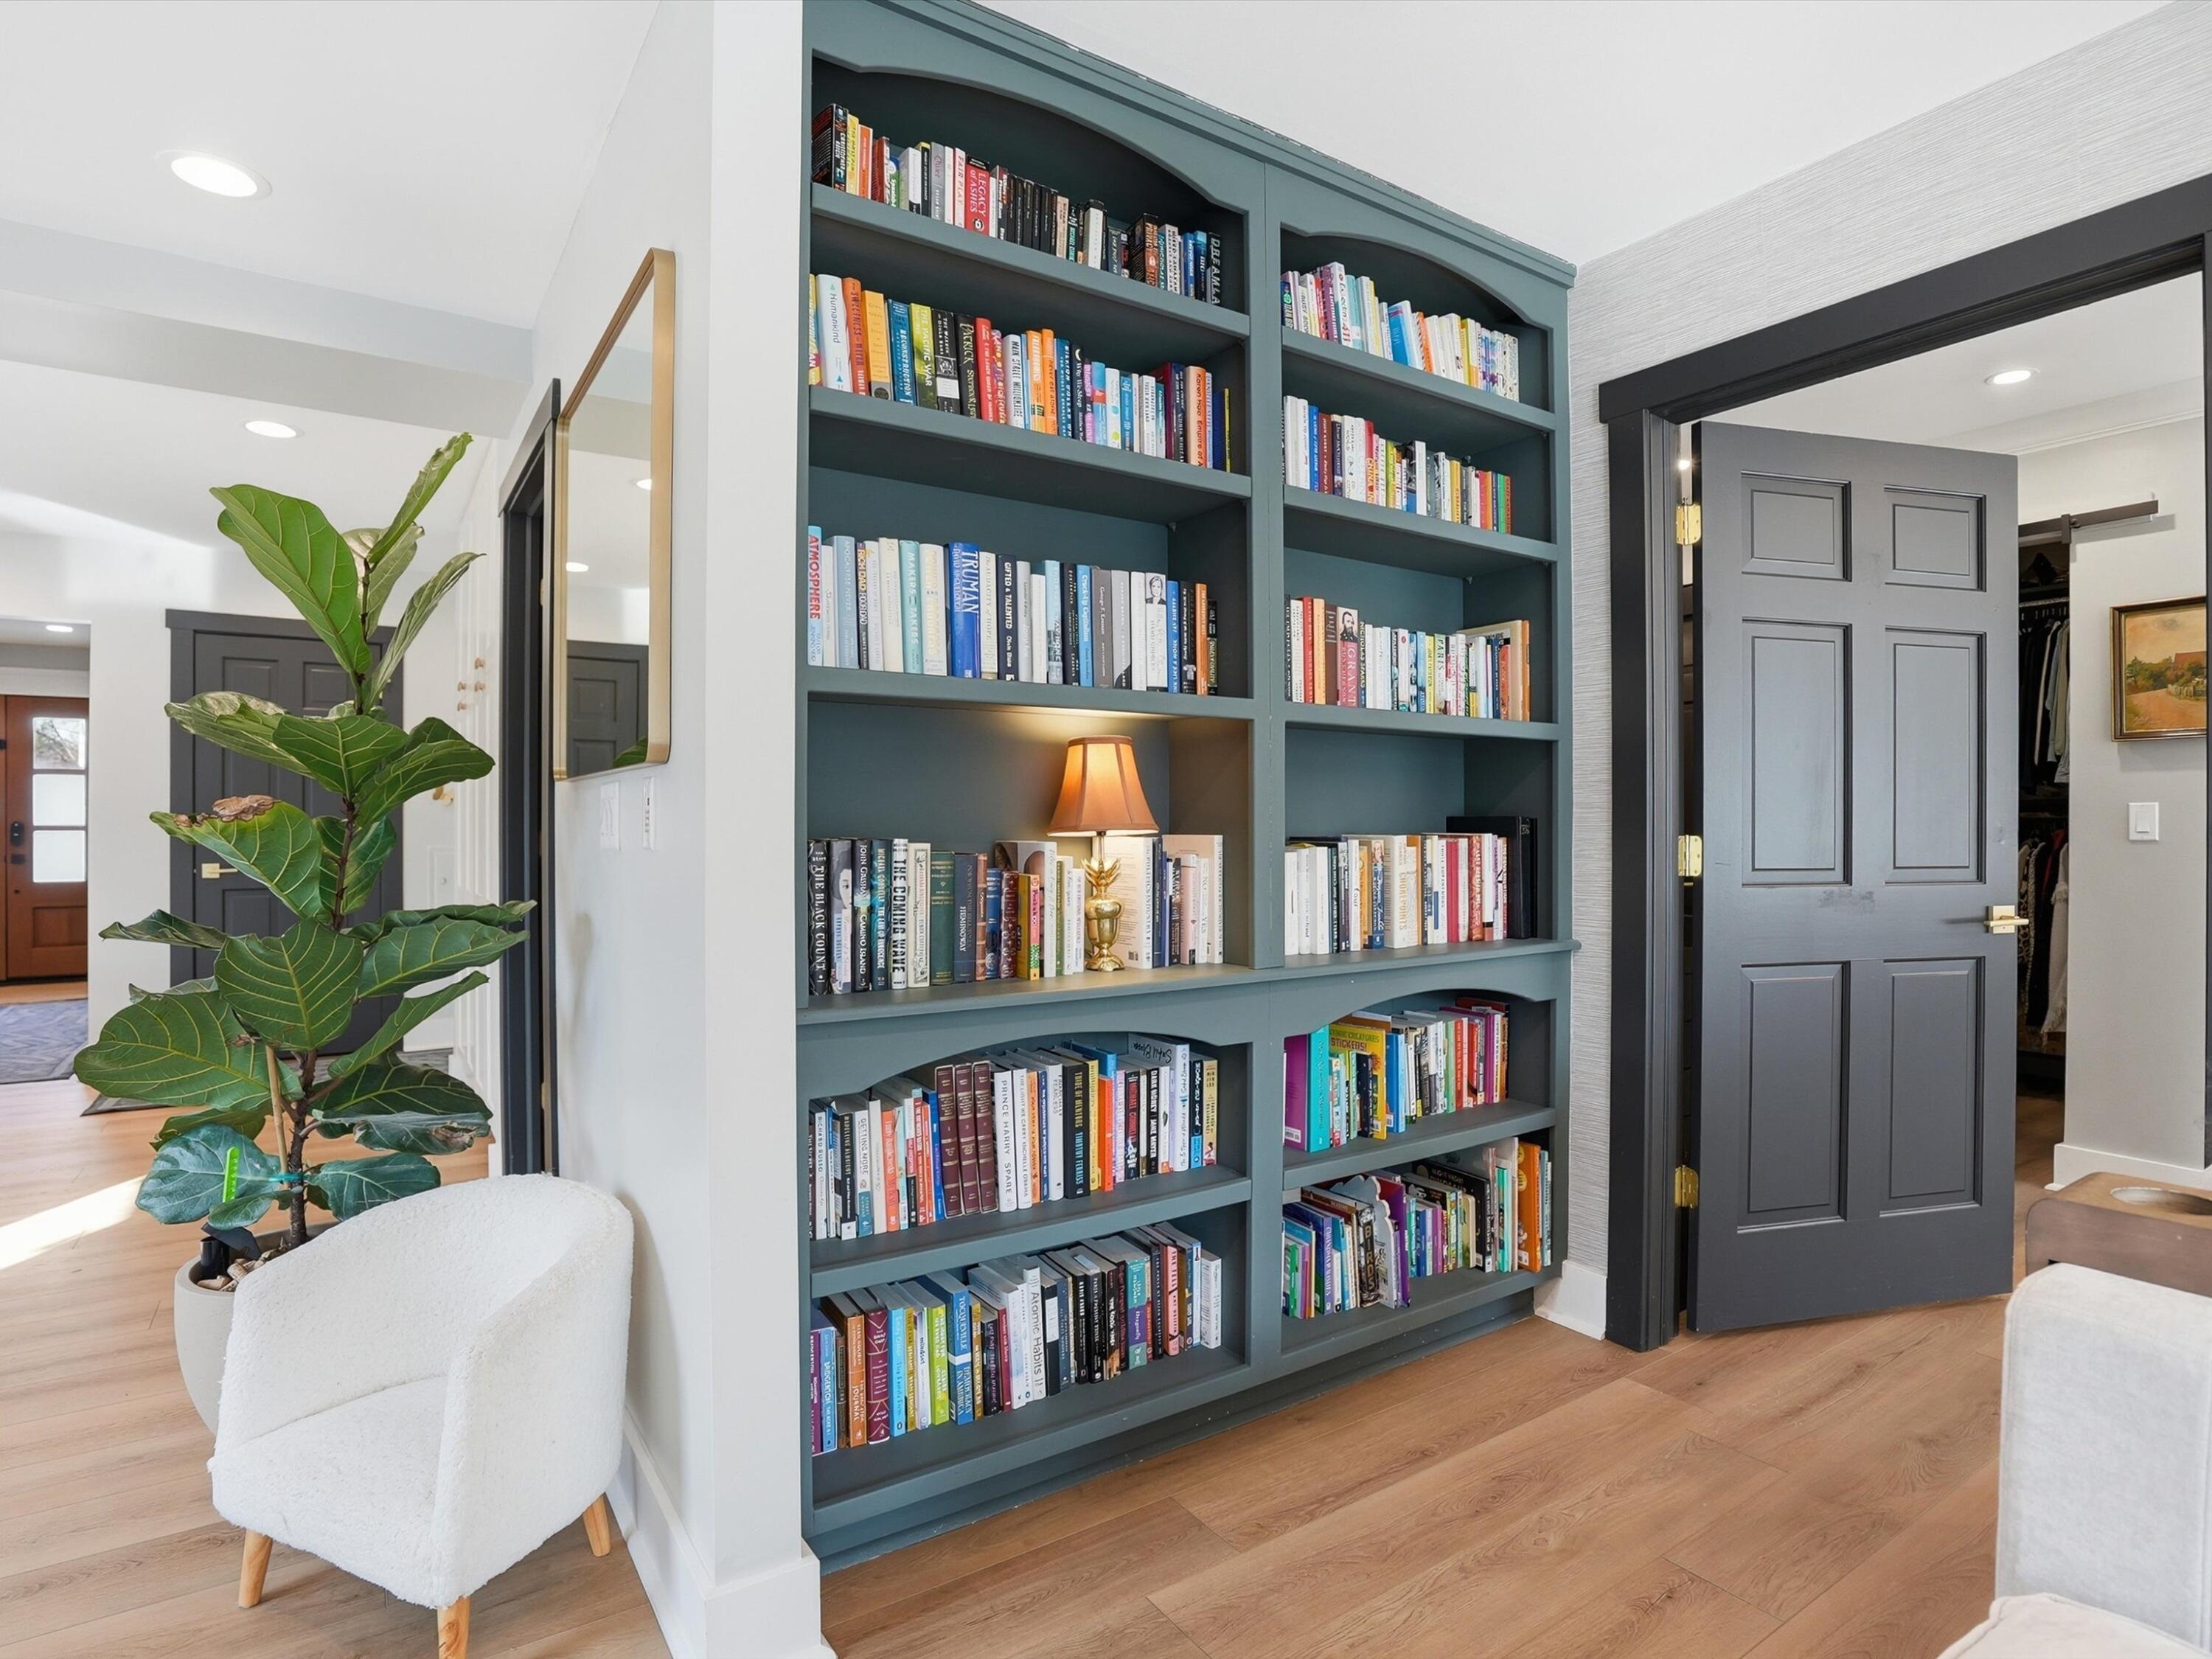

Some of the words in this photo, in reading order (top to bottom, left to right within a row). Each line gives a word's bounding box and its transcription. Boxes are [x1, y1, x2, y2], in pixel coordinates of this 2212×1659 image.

[970, 170, 977, 178] of
[970, 179, 978, 213] ASHES
[978, 173, 987, 218] LEGACY
[1210, 237, 1221, 304] DREAMLA
[830, 293, 841, 343] Humankind
[922, 328, 931, 361] PACIFIC
[959, 323, 974, 366] PATRICK
[900, 329, 912, 397] RECONSTRUCTION
[924, 364, 933, 386] WAR
[1012, 358, 1021, 378] STREET
[1012, 381, 1023, 417] MILLIONAIRE
[844, 540, 852, 584] APOCALYPSE
[858, 549, 866, 570] RICH
[908, 552, 917, 594] MAKERS
[1004, 563, 1012, 587] GIFTED
[808, 534, 821, 620] ATMOSPHERE
[858, 570, 867, 591] DAD
[961, 551, 979, 614] TRUMAN
[1081, 575, 1090, 605] Crack-Up
[910, 608, 919, 645] TAKERS
[1005, 594, 1014, 629] TALENTED
[1347, 648, 1356, 706] GRANT
[859, 844, 868, 864] JOHN
[893, 858, 907, 880] THE
[815, 866, 824, 889] THE
[859, 867, 868, 897] GRISHAM
[815, 894, 825, 928] BLACK
[892, 886, 907, 934] COMING
[1399, 872, 1408, 931] CHOKEPOINTS
[859, 914, 868, 946] CAMINO
[815, 933, 825, 970] COUNT
[859, 948, 868, 973] ISLAND
[892, 939, 905, 973] WAVE
[1330, 1037, 1368, 1052] STICKERS!
[1075, 1072, 1083, 1088] TRIBE
[1020, 1108, 1025, 1117] WE
[844, 1116, 852, 1147] MADELEINE
[1076, 1160, 1084, 1184] FERRISS
[1364, 1225, 1376, 1290] BIRDS
[958, 1296, 967, 1351] TOCQUEVILLE
[1031, 1292, 1040, 1335] Atomic
[1033, 1336, 1043, 1375] Habits
[964, 1367, 972, 1414] DEMOCRACY
